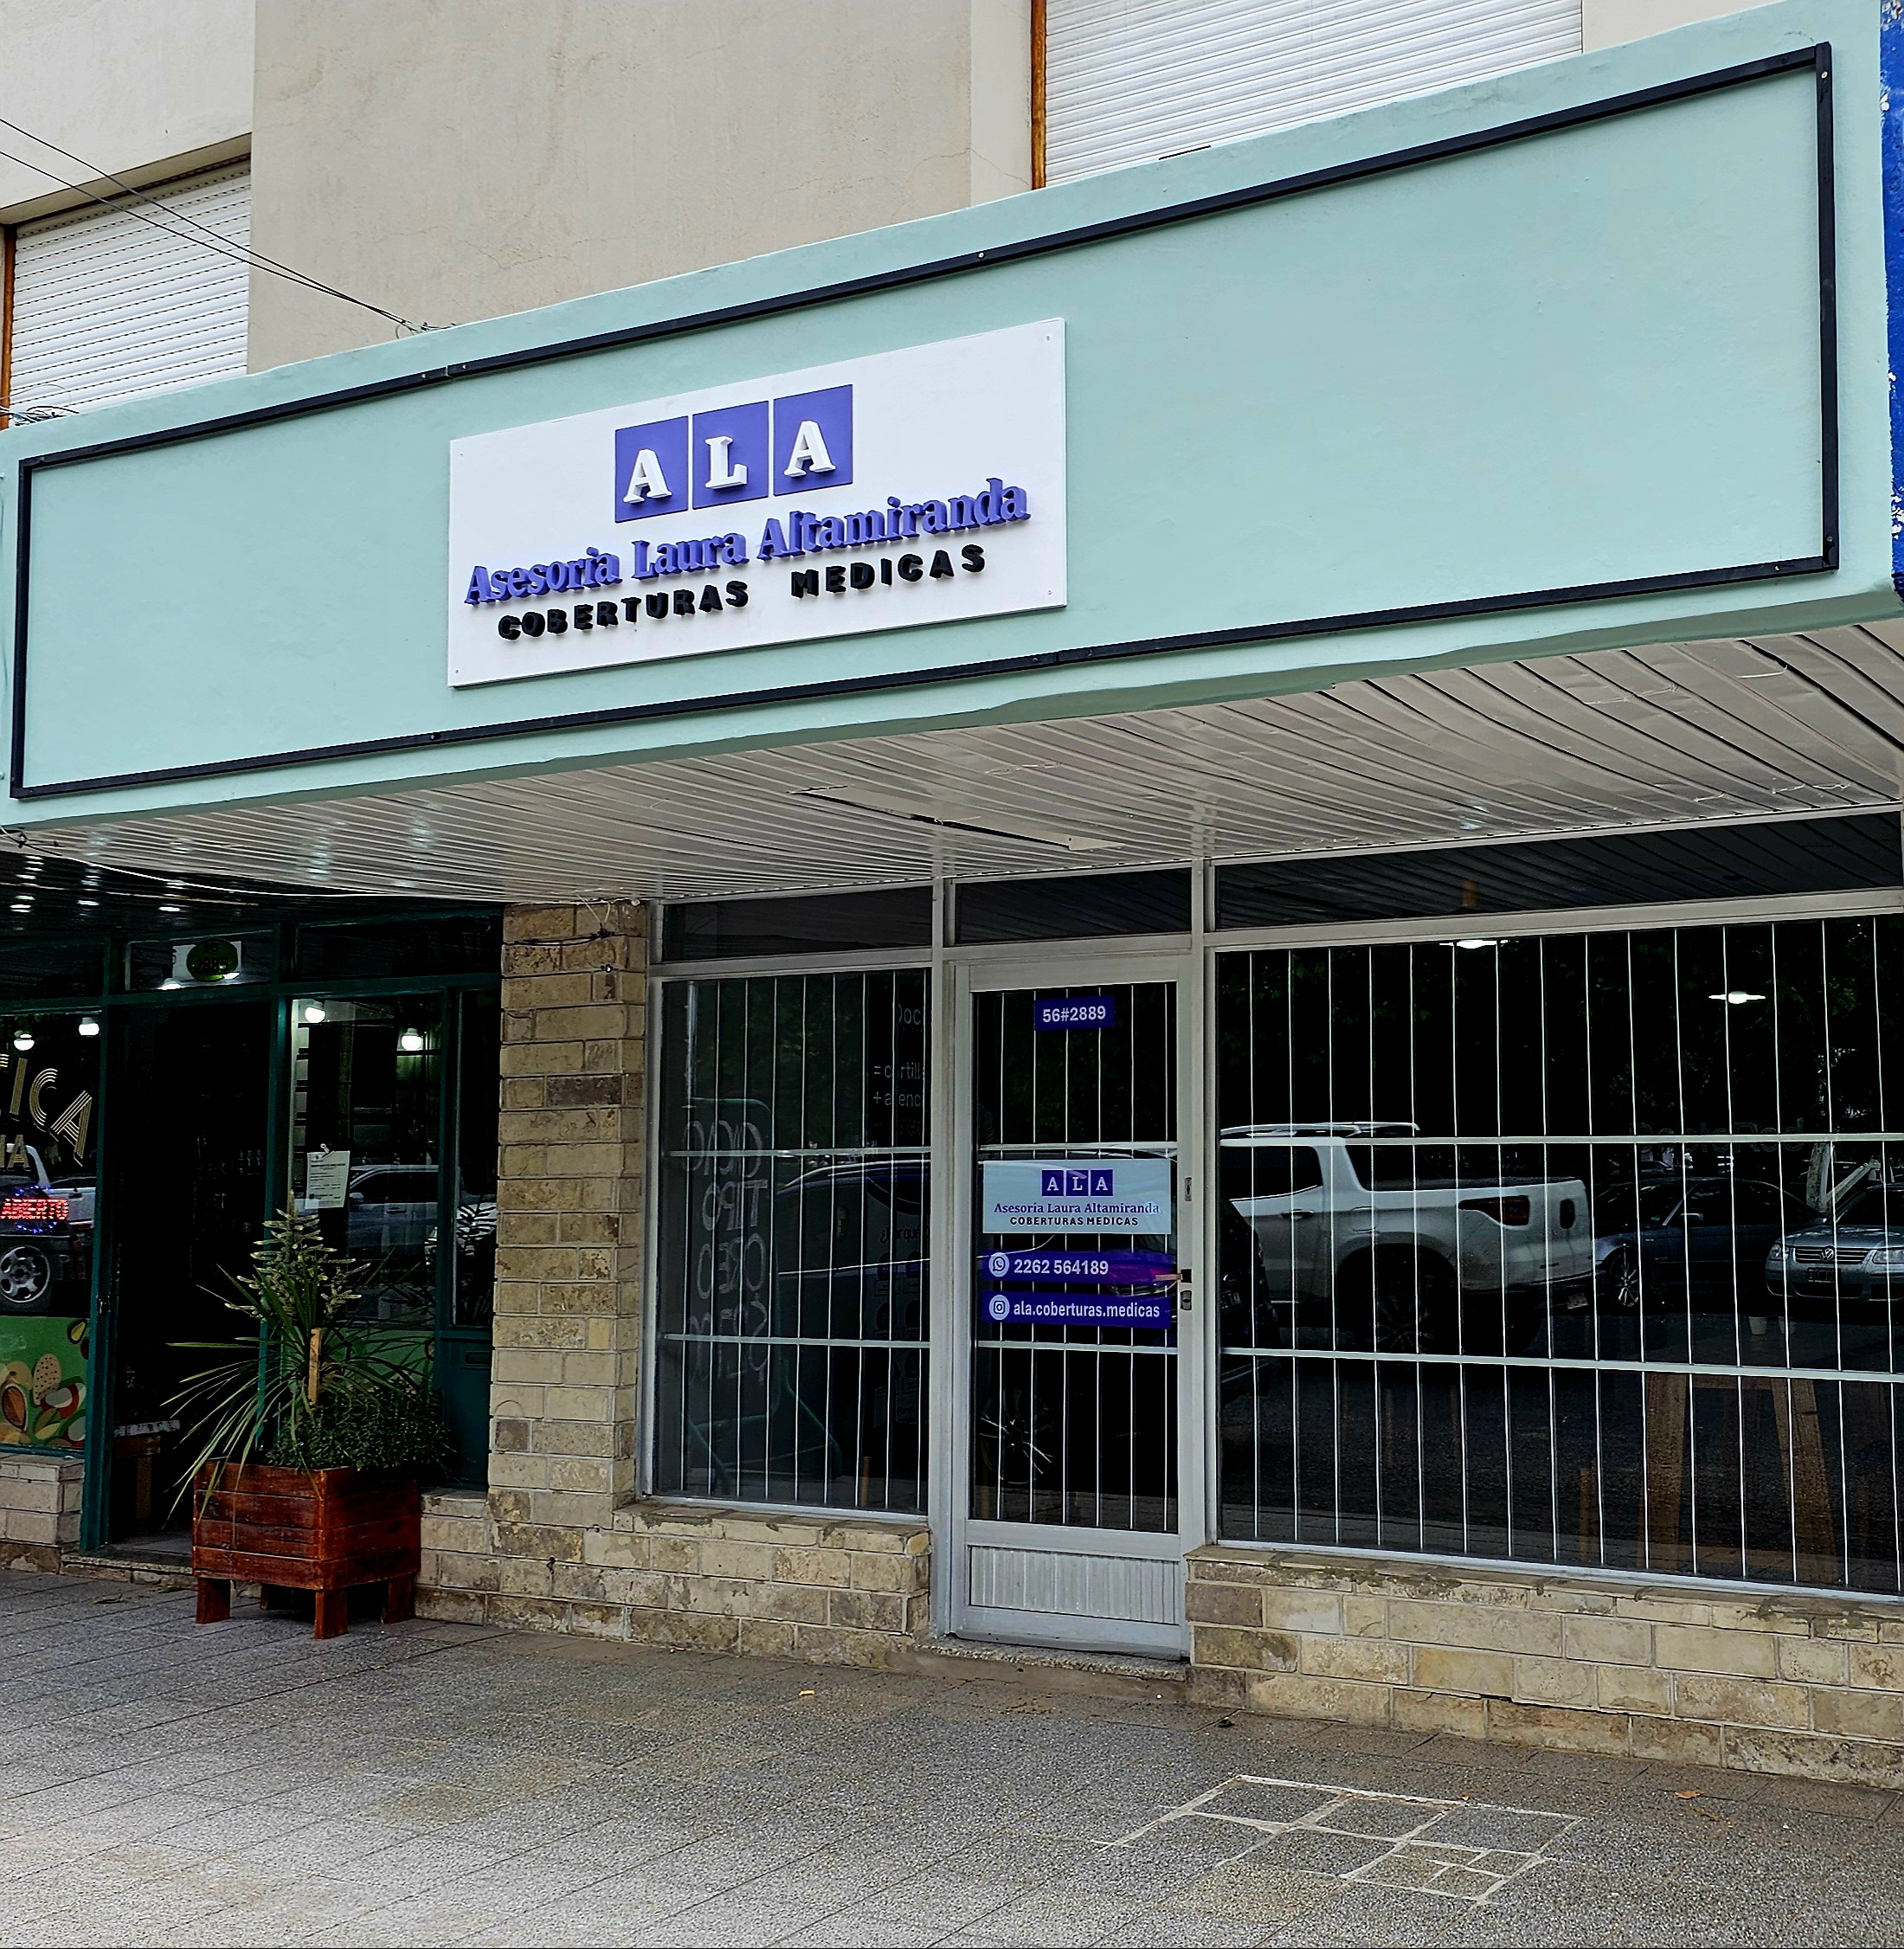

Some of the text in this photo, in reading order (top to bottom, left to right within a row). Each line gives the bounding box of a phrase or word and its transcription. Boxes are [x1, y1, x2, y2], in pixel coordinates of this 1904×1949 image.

[620, 410, 841, 509] ALA
[631, 531, 749, 580] Laura
[756, 478, 1031, 561] Altamiranda
[498, 544, 986, 641] COBERTURAS MEDICAS
[1042, 1006, 1106, 1023] 56#2889
[1045, 1174, 1110, 1193] ALA
[994, 1202, 1160, 1213] Asesoría Laura Altamiranda
[1010, 1216, 1139, 1226] COBERTURAS MEDICAS
[1013, 1259, 1109, 1275] 2262 564189
[1013, 1301, 1161, 1318] ala.coberturas.medicas
